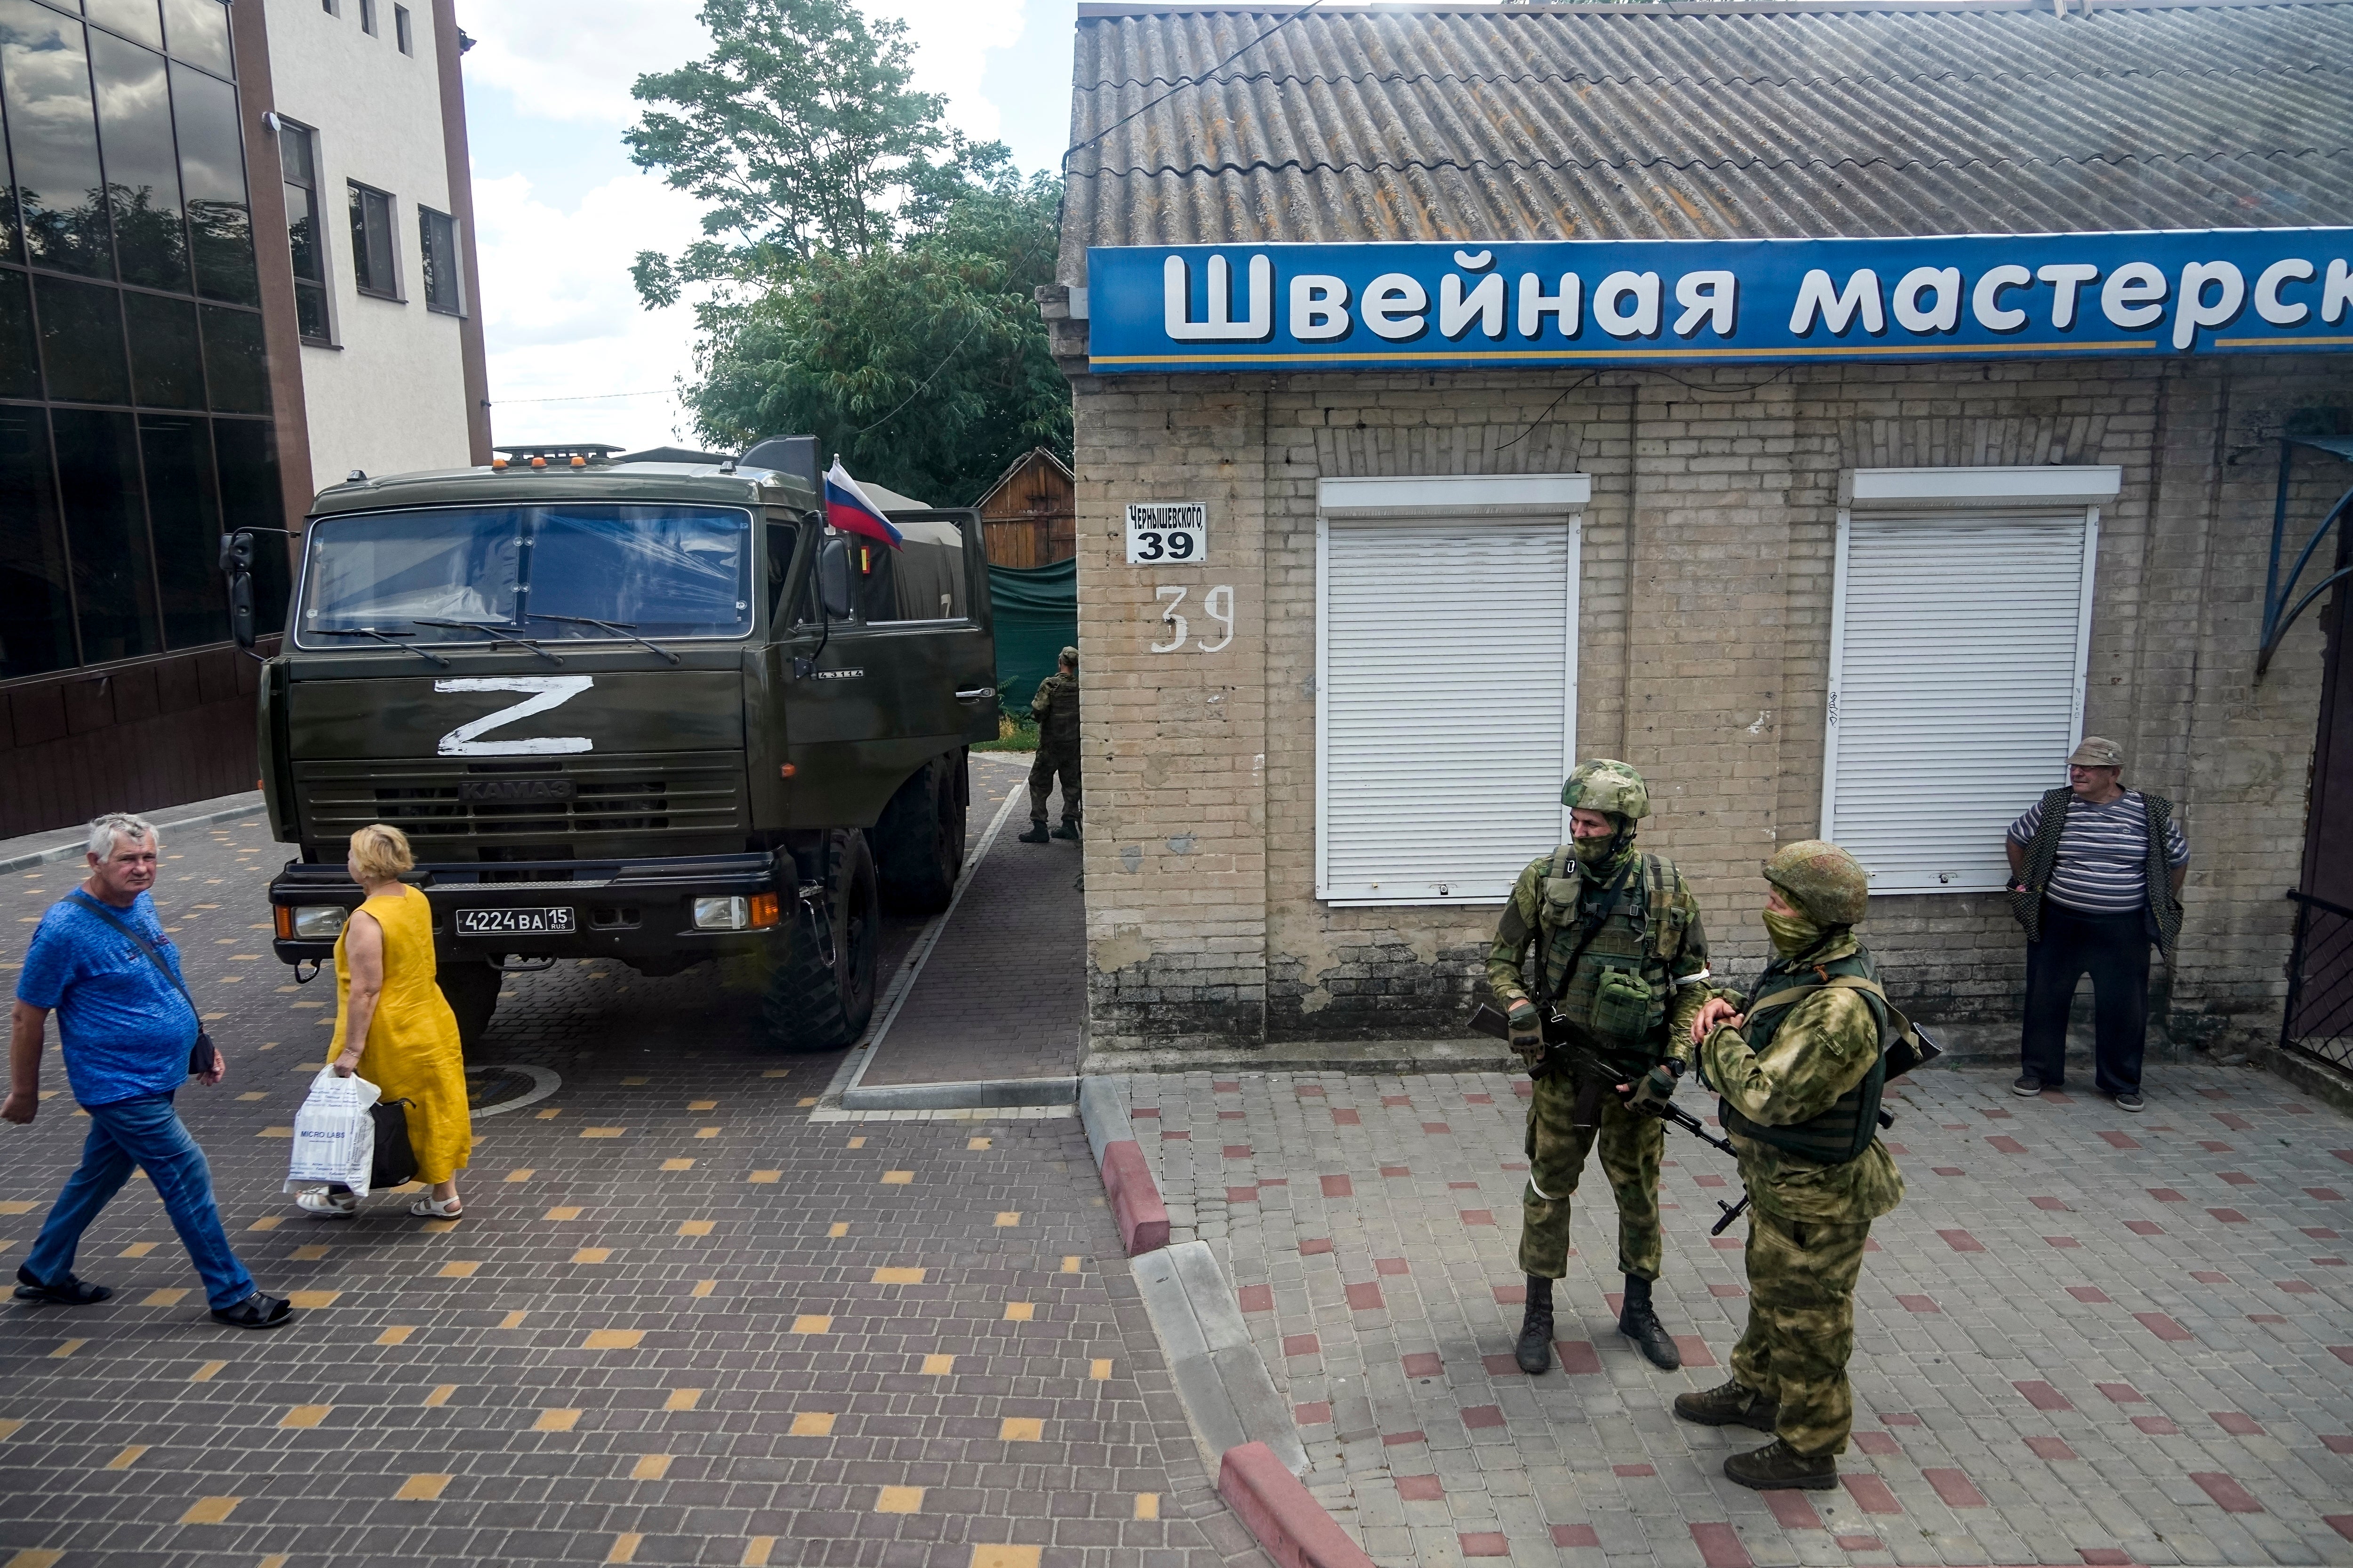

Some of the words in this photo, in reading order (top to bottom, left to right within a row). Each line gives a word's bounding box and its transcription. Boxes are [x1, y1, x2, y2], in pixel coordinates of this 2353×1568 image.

[1163, 250, 1735, 339] Швейная
[1789, 258, 2353, 349] мастерск
[1137, 531, 1194, 560] 39
[1151, 585, 1234, 653] 39
[434, 675, 594, 756] Z
[462, 780, 573, 800] КАМАЗ
[548, 909, 568, 924] 15
